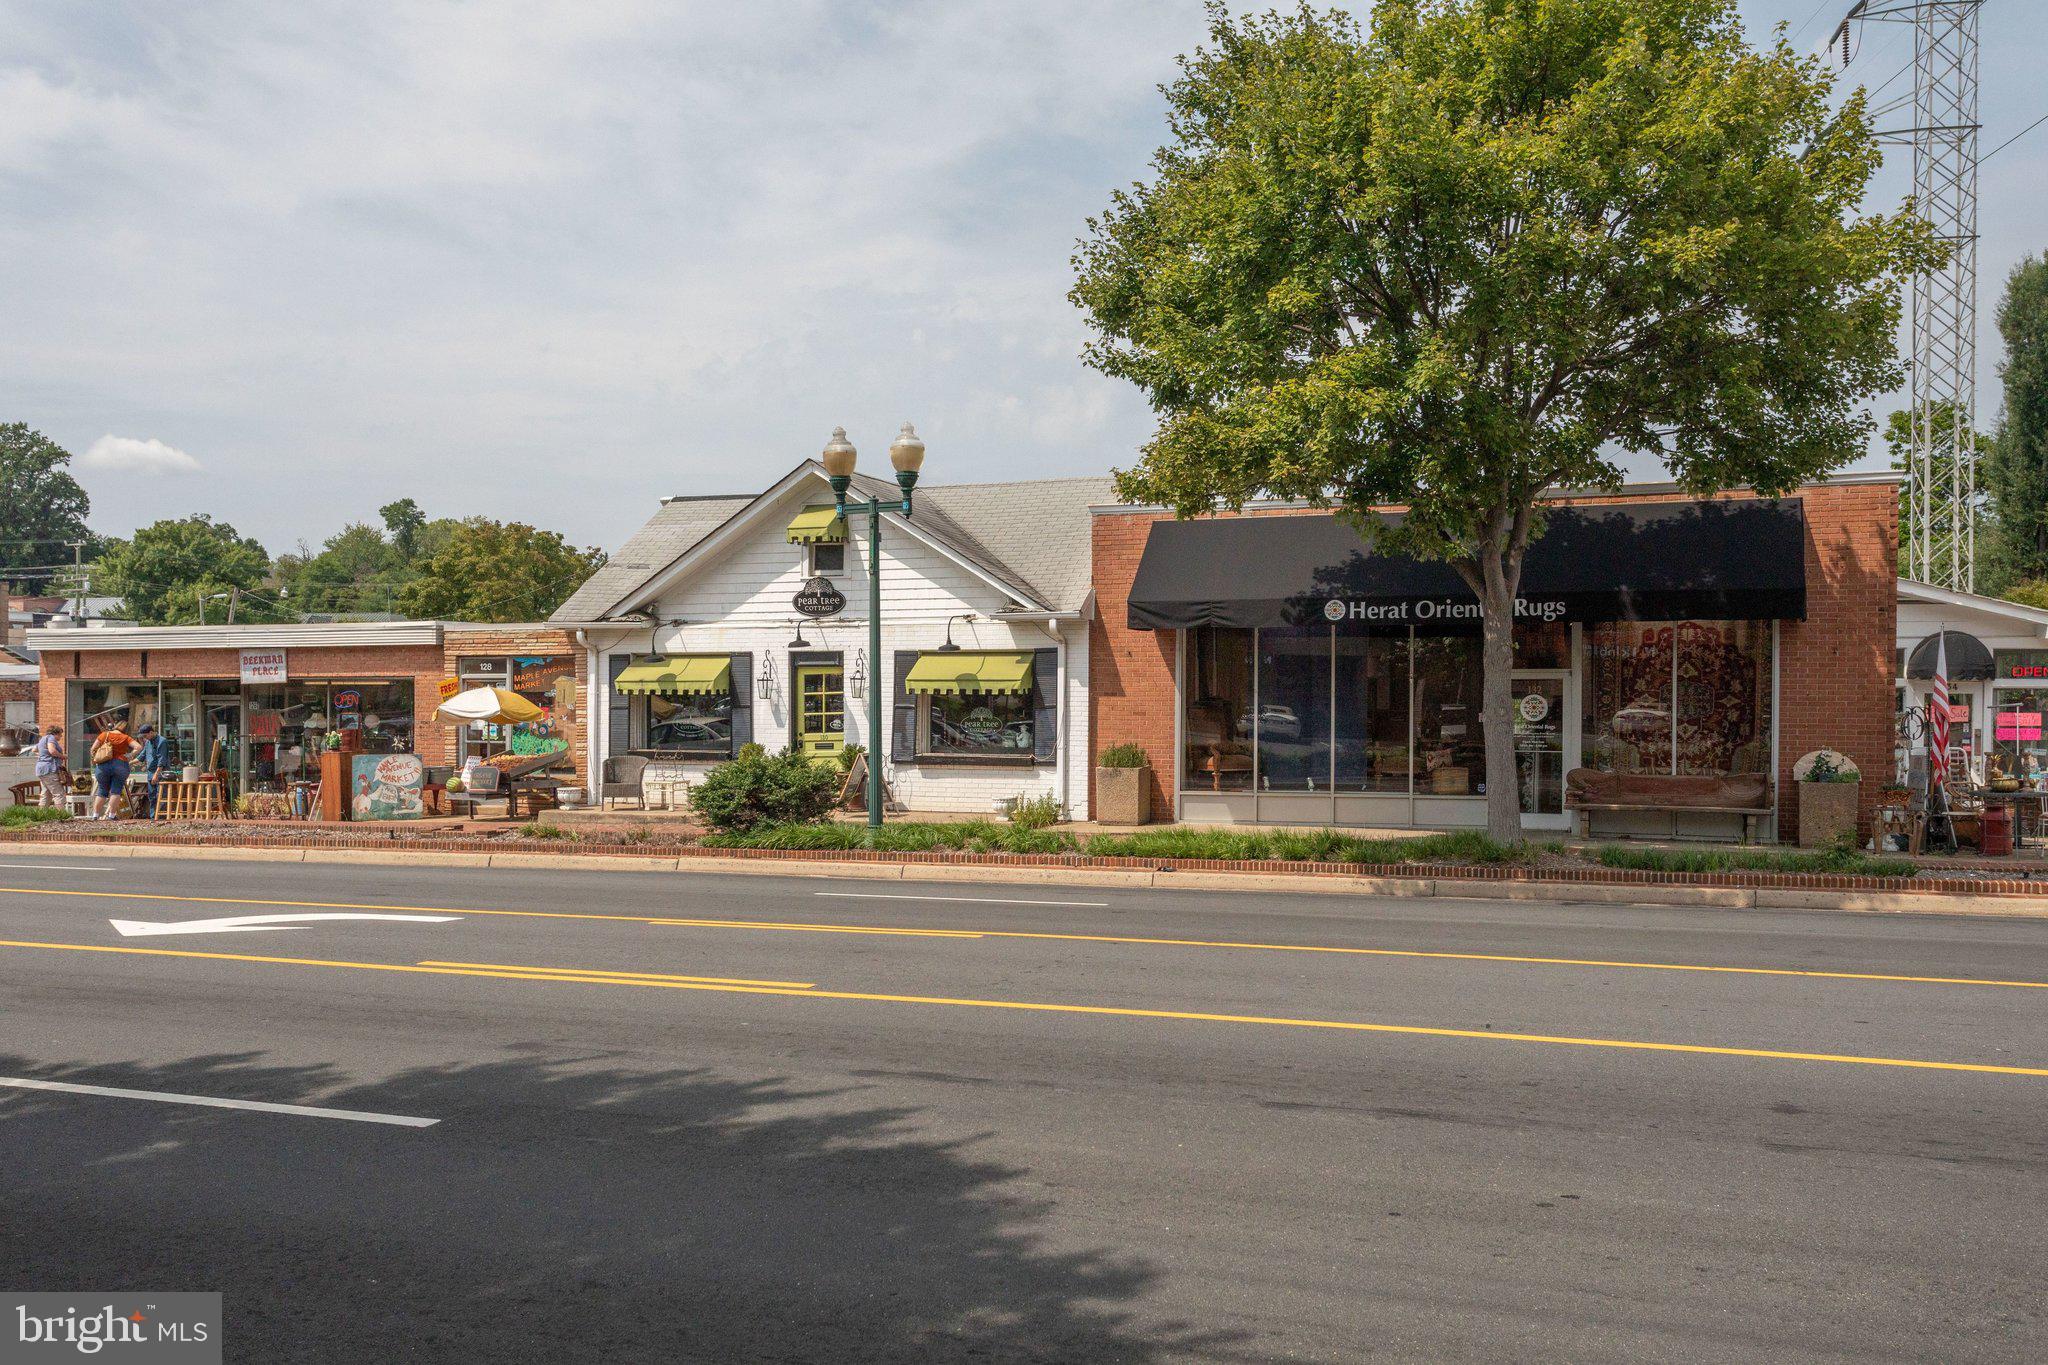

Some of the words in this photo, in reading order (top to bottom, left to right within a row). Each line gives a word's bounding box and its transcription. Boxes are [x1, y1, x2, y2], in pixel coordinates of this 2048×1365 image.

[1349, 600, 1408, 619] Herat
[1415, 599, 1484, 619] Orient
[1514, 598, 1566, 622] Rugs
[252, 666, 279, 676] PLACE
[480, 662, 492, 671] 128
[514, 671, 540, 682] MAPLE
[334, 694, 360, 706] OPEN
